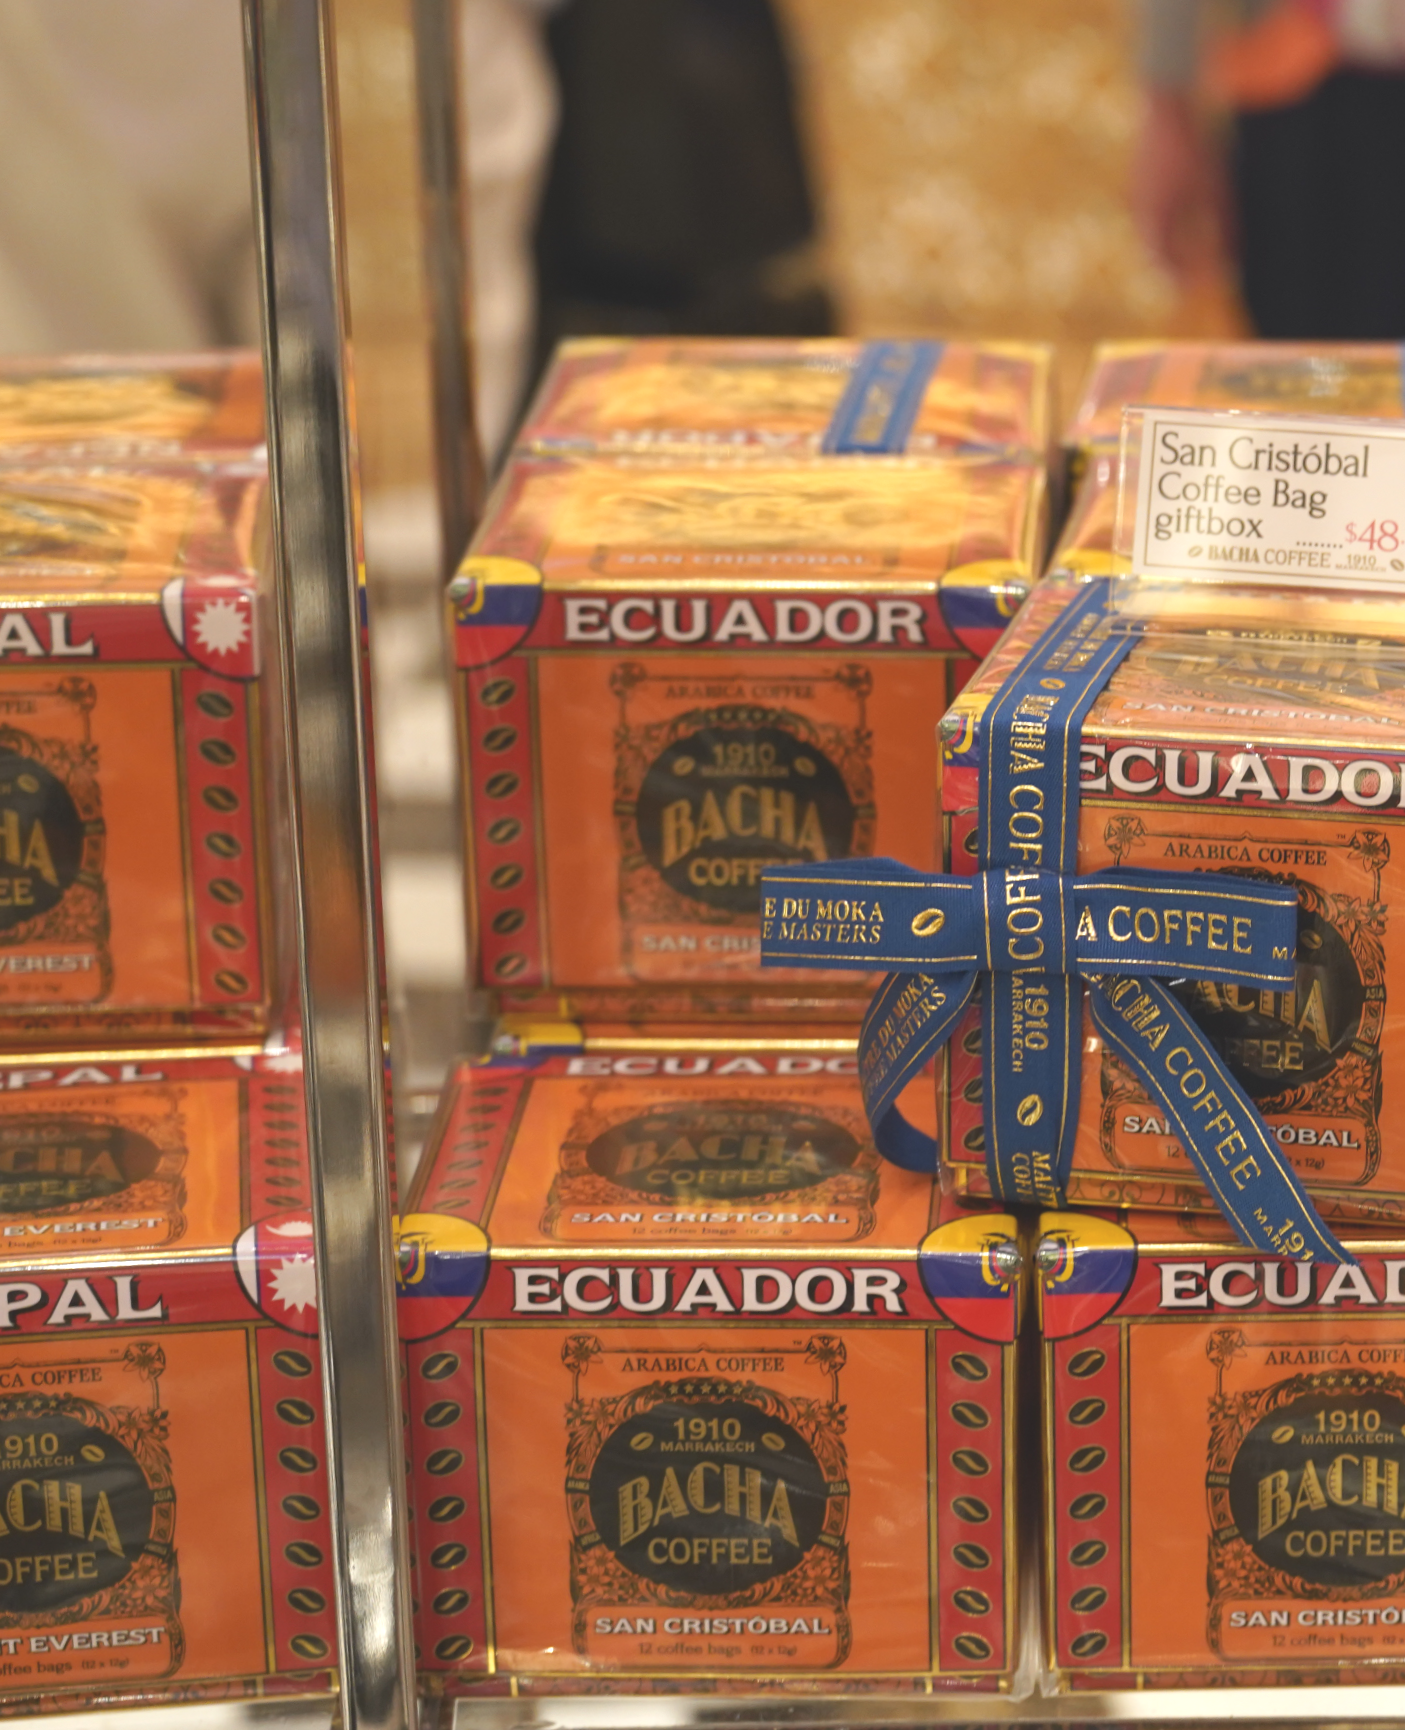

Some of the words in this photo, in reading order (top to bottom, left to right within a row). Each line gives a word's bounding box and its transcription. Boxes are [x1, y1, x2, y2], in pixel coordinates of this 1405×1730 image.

[1160, 431, 1217, 467] San
[1229, 436, 1370, 478] Cristóbal
[1158, 471, 1261, 506] Coffee
[1273, 479, 1328, 520] Bag
[1154, 506, 1264, 541] giftbox
[1208, 546, 1260, 564] BACHA
[1264, 550, 1331, 570] COFFEE
[1347, 554, 1377, 567] 1910
[563, 598, 925, 643] ECUADOR
[713, 743, 776, 766] 1910
[662, 784, 828, 868] BACHA
[1163, 842, 1251, 862] ARABICA
[1258, 848, 1327, 866] COFFEE
[782, 899, 810, 920] DU
[816, 900, 884, 923] MOKA
[779, 922, 881, 944] MASTERS
[1108, 905, 1252, 955] COFFEE
[642, 936, 697, 953] SAN
[1011, 977, 1024, 1073] ARRAKECH
[1025, 984, 1049, 1050] 1910
[1165, 1047, 1262, 1191] COFFEE
[615, 1134, 823, 1176] BACHA
[1166, 1145, 1180, 1158] 12
[646, 1168, 790, 1186] COFFEE
[4, 1217, 163, 1237] EVEREST
[571, 1212, 643, 1224] SAN
[512, 1267, 906, 1317] ECUADOR
[622, 1357, 710, 1373] ARABICA
[716, 1357, 784, 1373] COFFEE
[1265, 1350, 1352, 1366] ARABICA
[31, 1367, 102, 1387] COFFEE
[673, 1417, 741, 1441] 1910
[1315, 1410, 1381, 1434] 1910
[660, 1441, 755, 1453] MARRAKECH
[1301, 1433, 1395, 1445] MARRAKECH
[618, 1461, 799, 1547] BACHA
[648, 1538, 773, 1565] COFFEE
[595, 1618, 657, 1634] SAN
[663, 1615, 831, 1635] CRISTÓBAL
[1230, 1611, 1291, 1628] SAN
[30, 1627, 165, 1653] EVEREST
[658, 1641, 703, 1655] coffee
[709, 1642, 742, 1658] bags
[1272, 1635, 1286, 1647] 12
[1290, 1634, 1336, 1648] coffee
[1340, 1634, 1374, 1650] bags
[37, 1661, 72, 1674] bags
